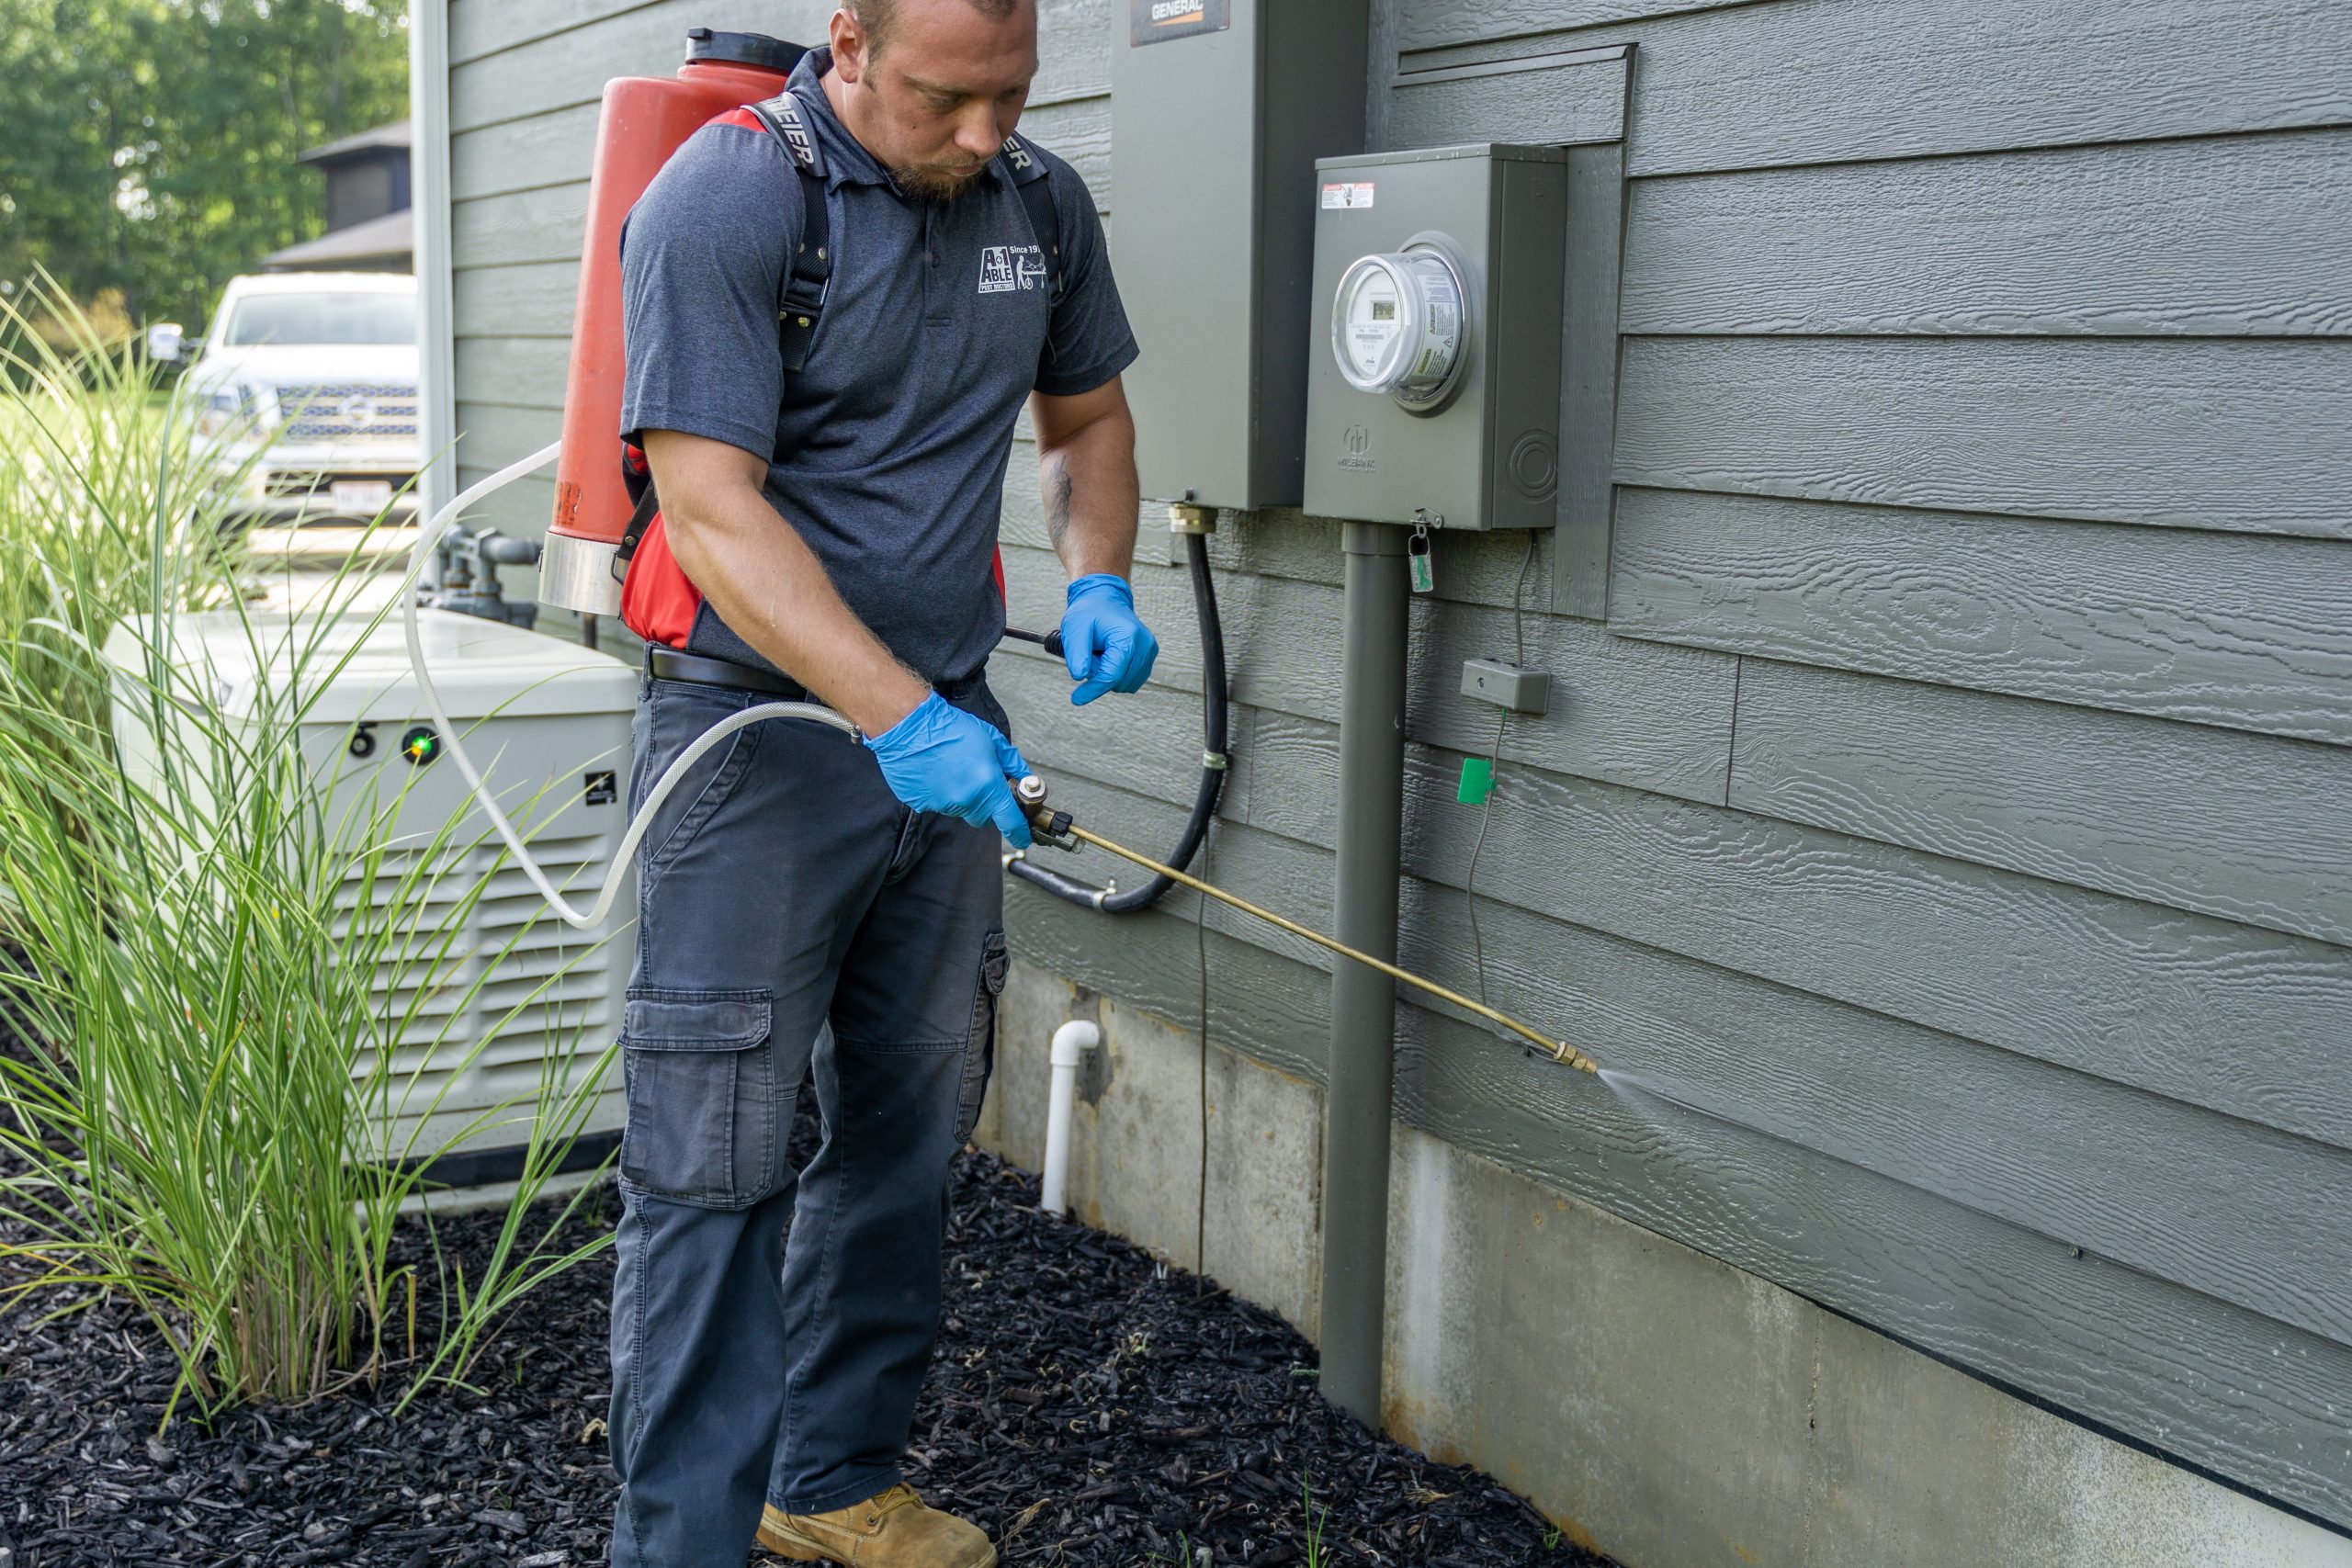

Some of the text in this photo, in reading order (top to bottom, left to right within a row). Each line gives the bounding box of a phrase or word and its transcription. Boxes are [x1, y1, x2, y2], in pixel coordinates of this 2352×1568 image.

[1152, 0, 1202, 20] GENERAC
[1010, 245, 1027, 254] Since
[981, 268, 1012, 283] ABLE
